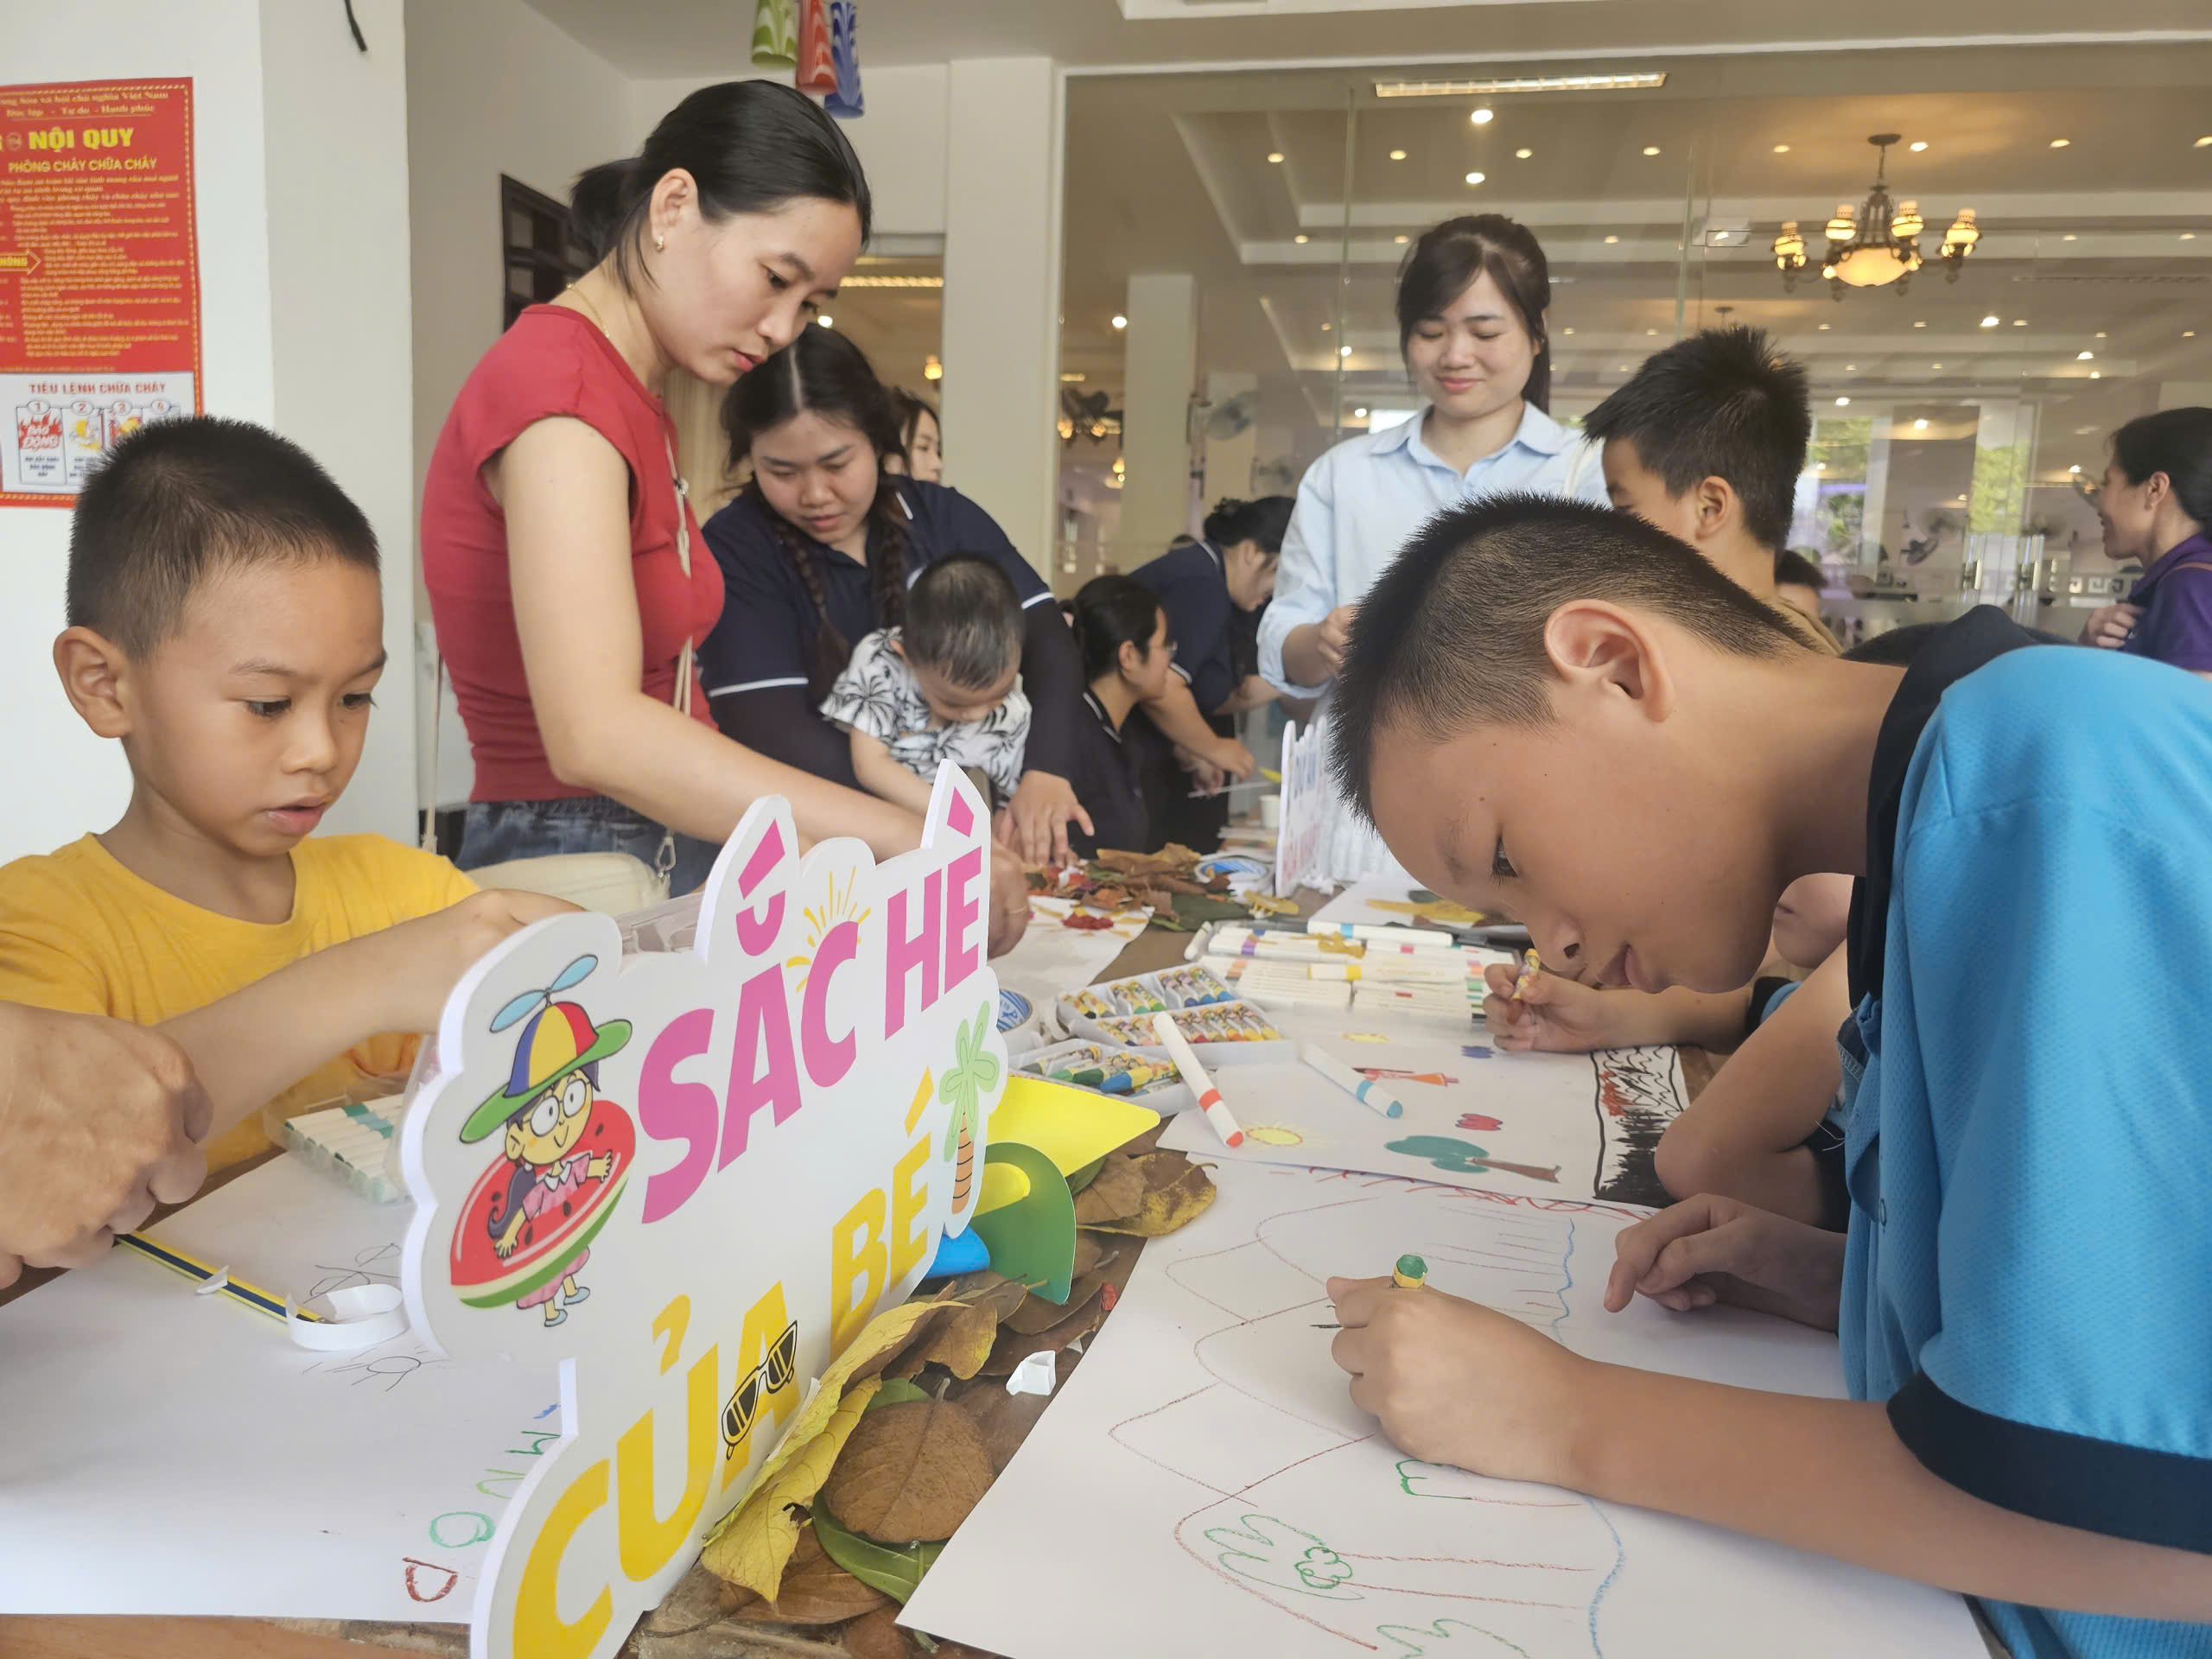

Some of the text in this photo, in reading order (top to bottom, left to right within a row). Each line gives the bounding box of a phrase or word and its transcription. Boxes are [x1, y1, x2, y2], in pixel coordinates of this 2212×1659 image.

[8, 155, 157, 173] PHÒNG CHÁY CHỮA CHÁY
[29, 126, 75, 152] NỘI
[82, 127, 134, 149] QUY
[639, 786, 982, 1224] SẮC HÈ
[513, 1065, 935, 1659] CỦA BÉ
